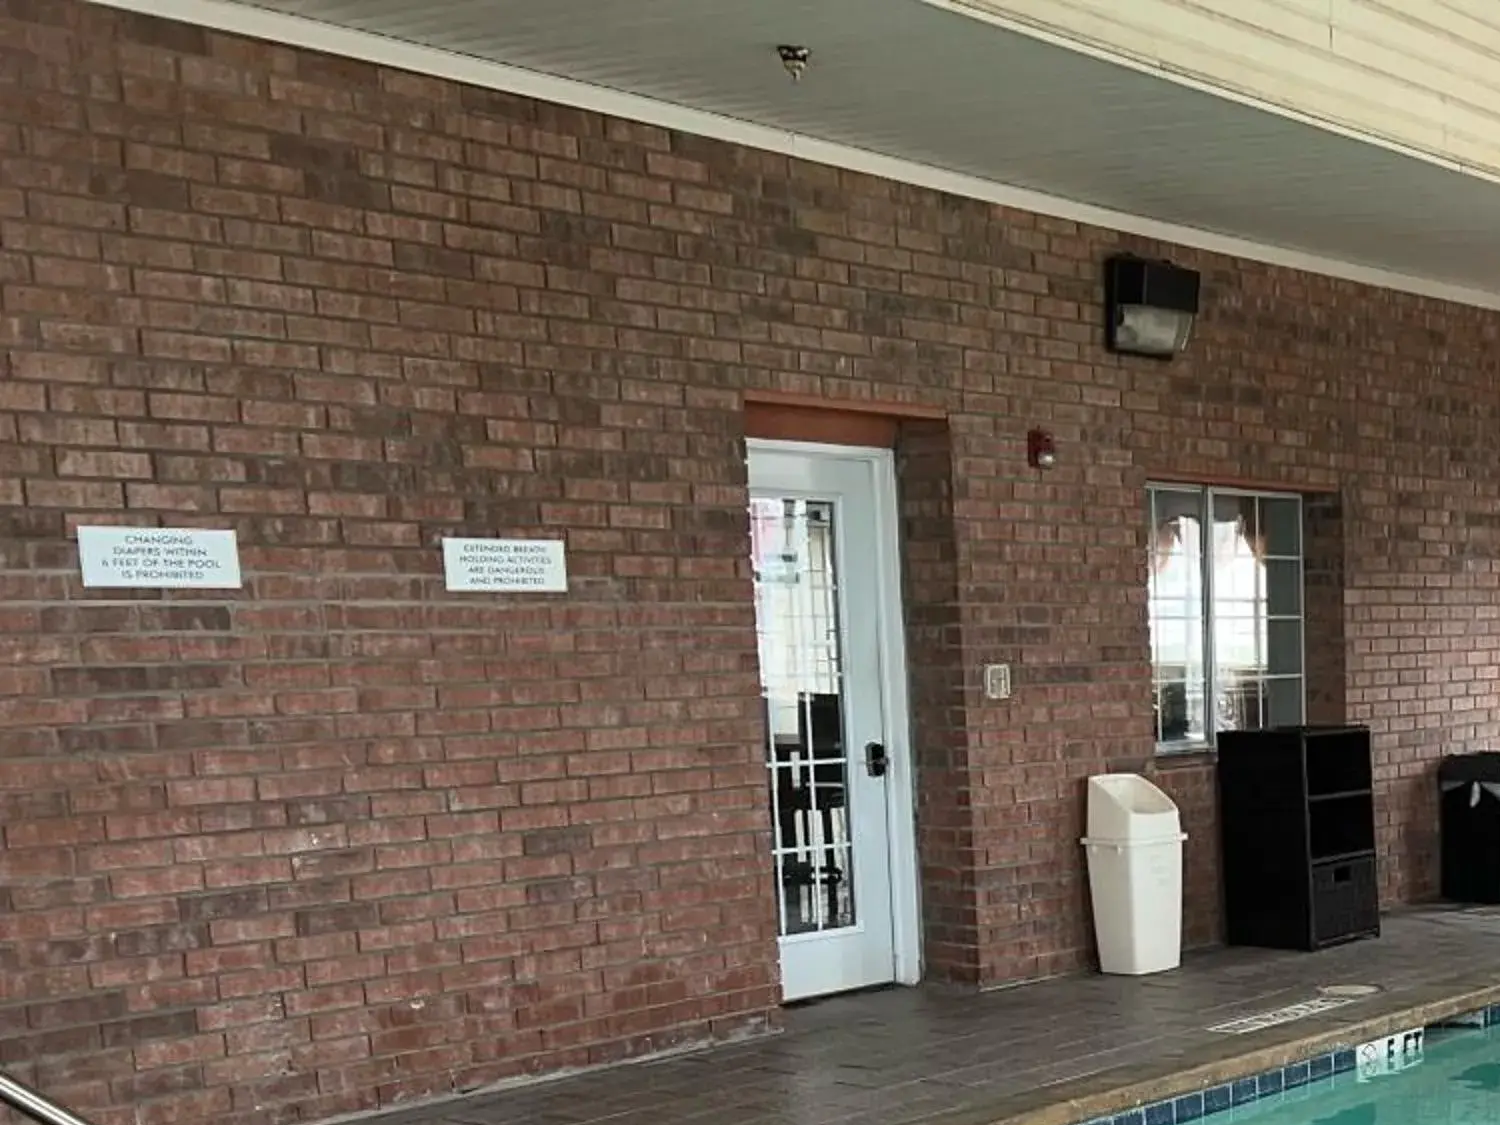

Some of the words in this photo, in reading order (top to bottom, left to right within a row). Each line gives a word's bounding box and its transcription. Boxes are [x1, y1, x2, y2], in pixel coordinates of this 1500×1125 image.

[124, 535, 193, 545] CHANGING
[112, 546, 161, 556] DIAPERS
[165, 547, 208, 557] WITHIN
[463, 544, 510, 553] EXTENDED
[513, 545, 547, 553] BREATH
[112, 558, 139, 567] FEET
[142, 558, 159, 567] OF
[163, 559, 184, 568] THE
[188, 559, 222, 569] POOL
[459, 555, 505, 564] HOLDING
[507, 556, 552, 565] ACTIVITIES
[121, 570, 133, 579] IS
[135, 570, 204, 580] PROHIBITED
[468, 566, 484, 574] ARE
[487, 566, 545, 575] DANGEROUS
[470, 577, 490, 585] AND
[493, 577, 545, 585] PROHIBITED
